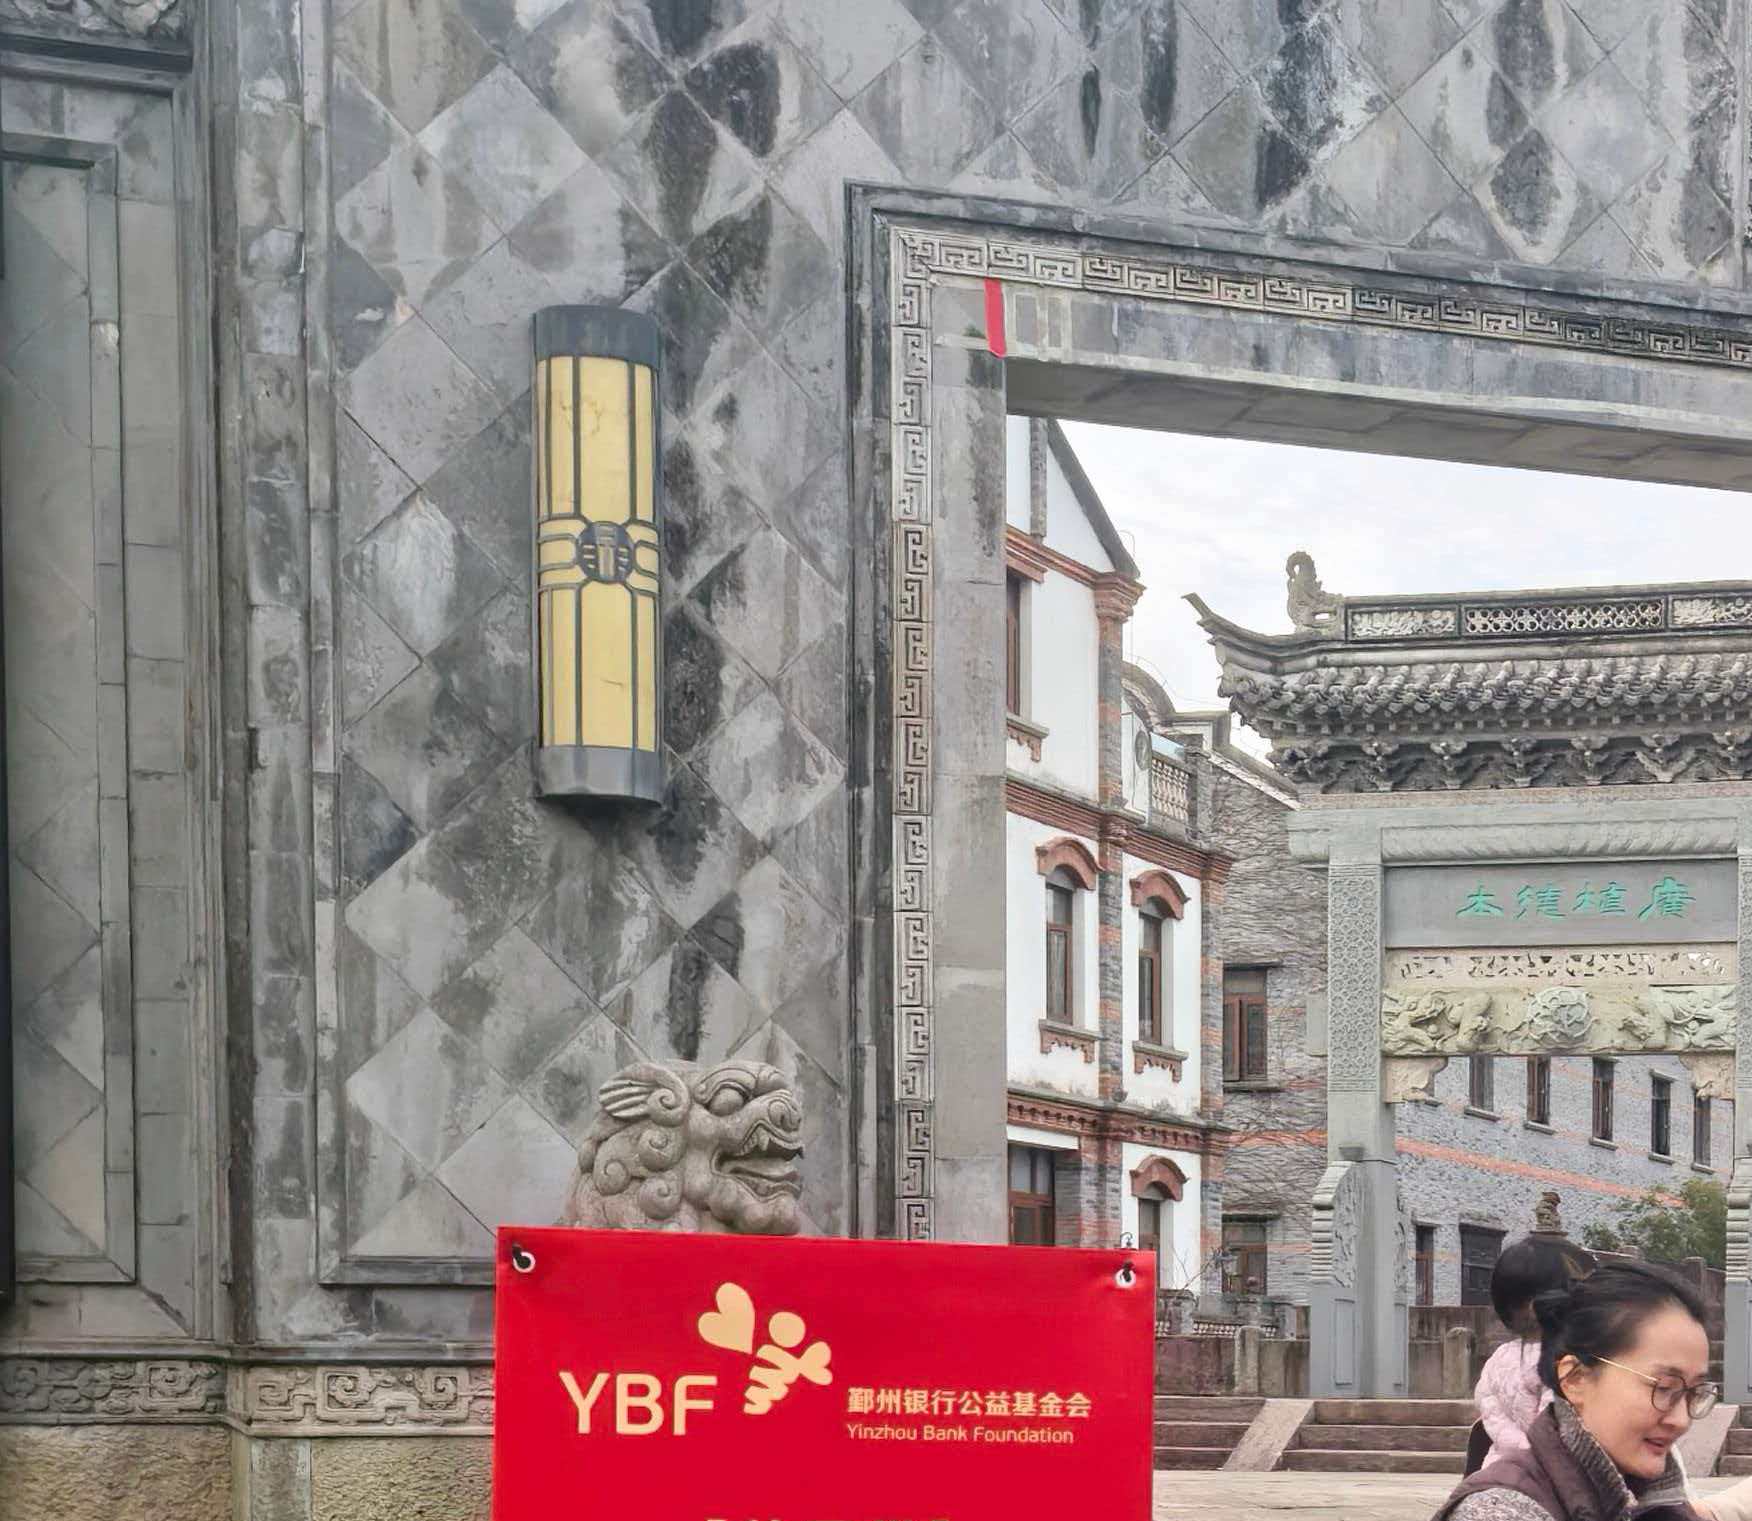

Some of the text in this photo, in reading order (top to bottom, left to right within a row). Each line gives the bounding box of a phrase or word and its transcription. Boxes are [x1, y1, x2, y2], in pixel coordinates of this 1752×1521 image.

[559, 1371, 718, 1436] YBF
[847, 1386, 1092, 1419] 鄞州银行公益基金会
[846, 1424, 1074, 1443] Yinzhou Bank Foundation
